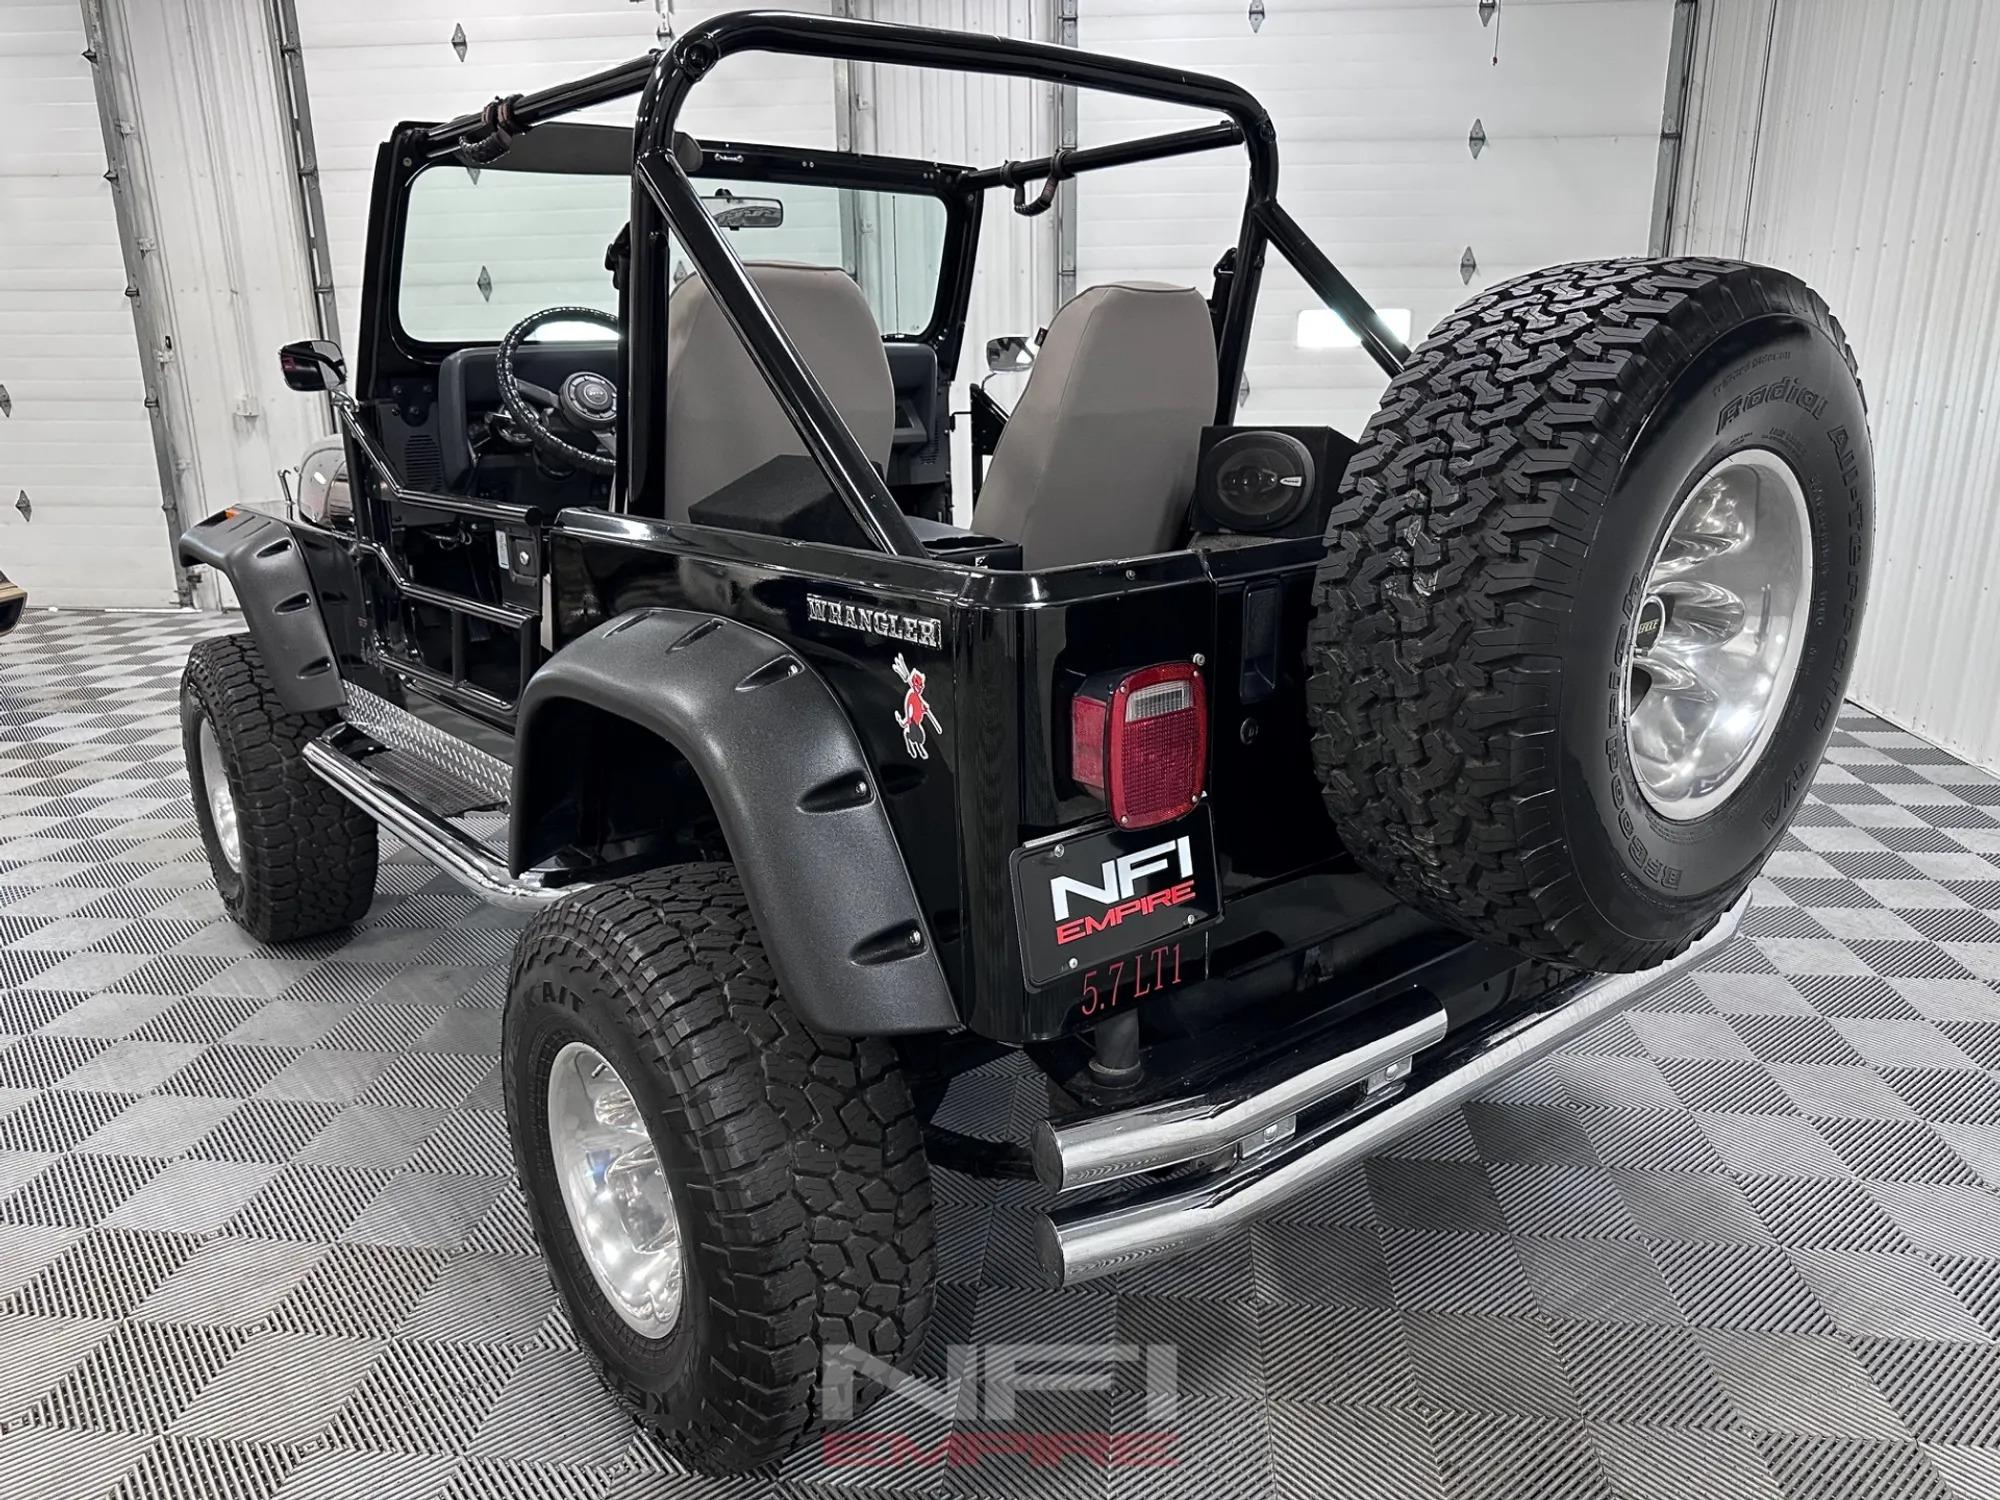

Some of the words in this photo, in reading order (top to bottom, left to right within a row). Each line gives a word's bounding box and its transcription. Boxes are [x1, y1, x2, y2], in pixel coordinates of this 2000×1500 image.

[1716, 376, 1829, 436] Radial
[807, 595, 941, 649] WRANGLER
[1050, 836, 1194, 921] NFI
[1056, 880, 1195, 945] EMPIRE
[1081, 961, 1124, 1016] 5.7
[1133, 943, 1182, 998] LT1
